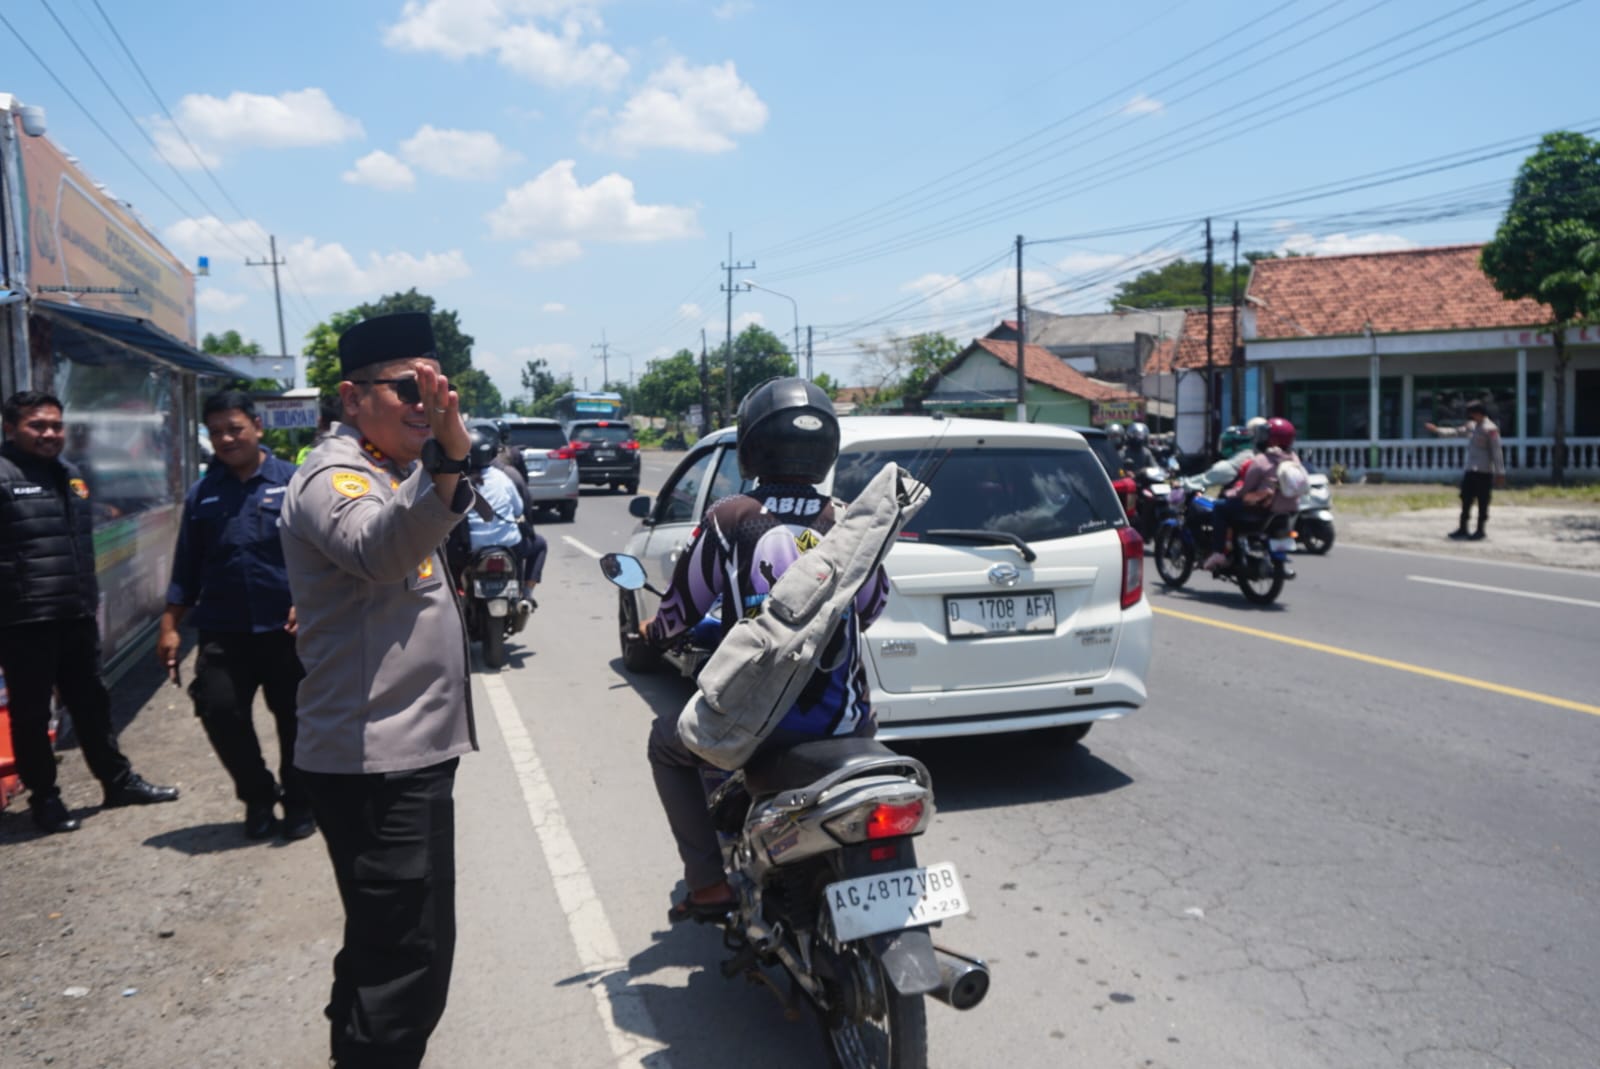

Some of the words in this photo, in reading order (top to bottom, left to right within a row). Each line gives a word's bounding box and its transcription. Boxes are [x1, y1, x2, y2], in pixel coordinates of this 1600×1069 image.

[764, 496, 821, 516] ABIB
[950, 602, 960, 621] D
[978, 599, 1015, 619] 1708
[1026, 596, 1053, 617] AFX
[835, 886, 861, 912] AG
[866, 875, 917, 902] 4872
[916, 868, 954, 892] VBB
